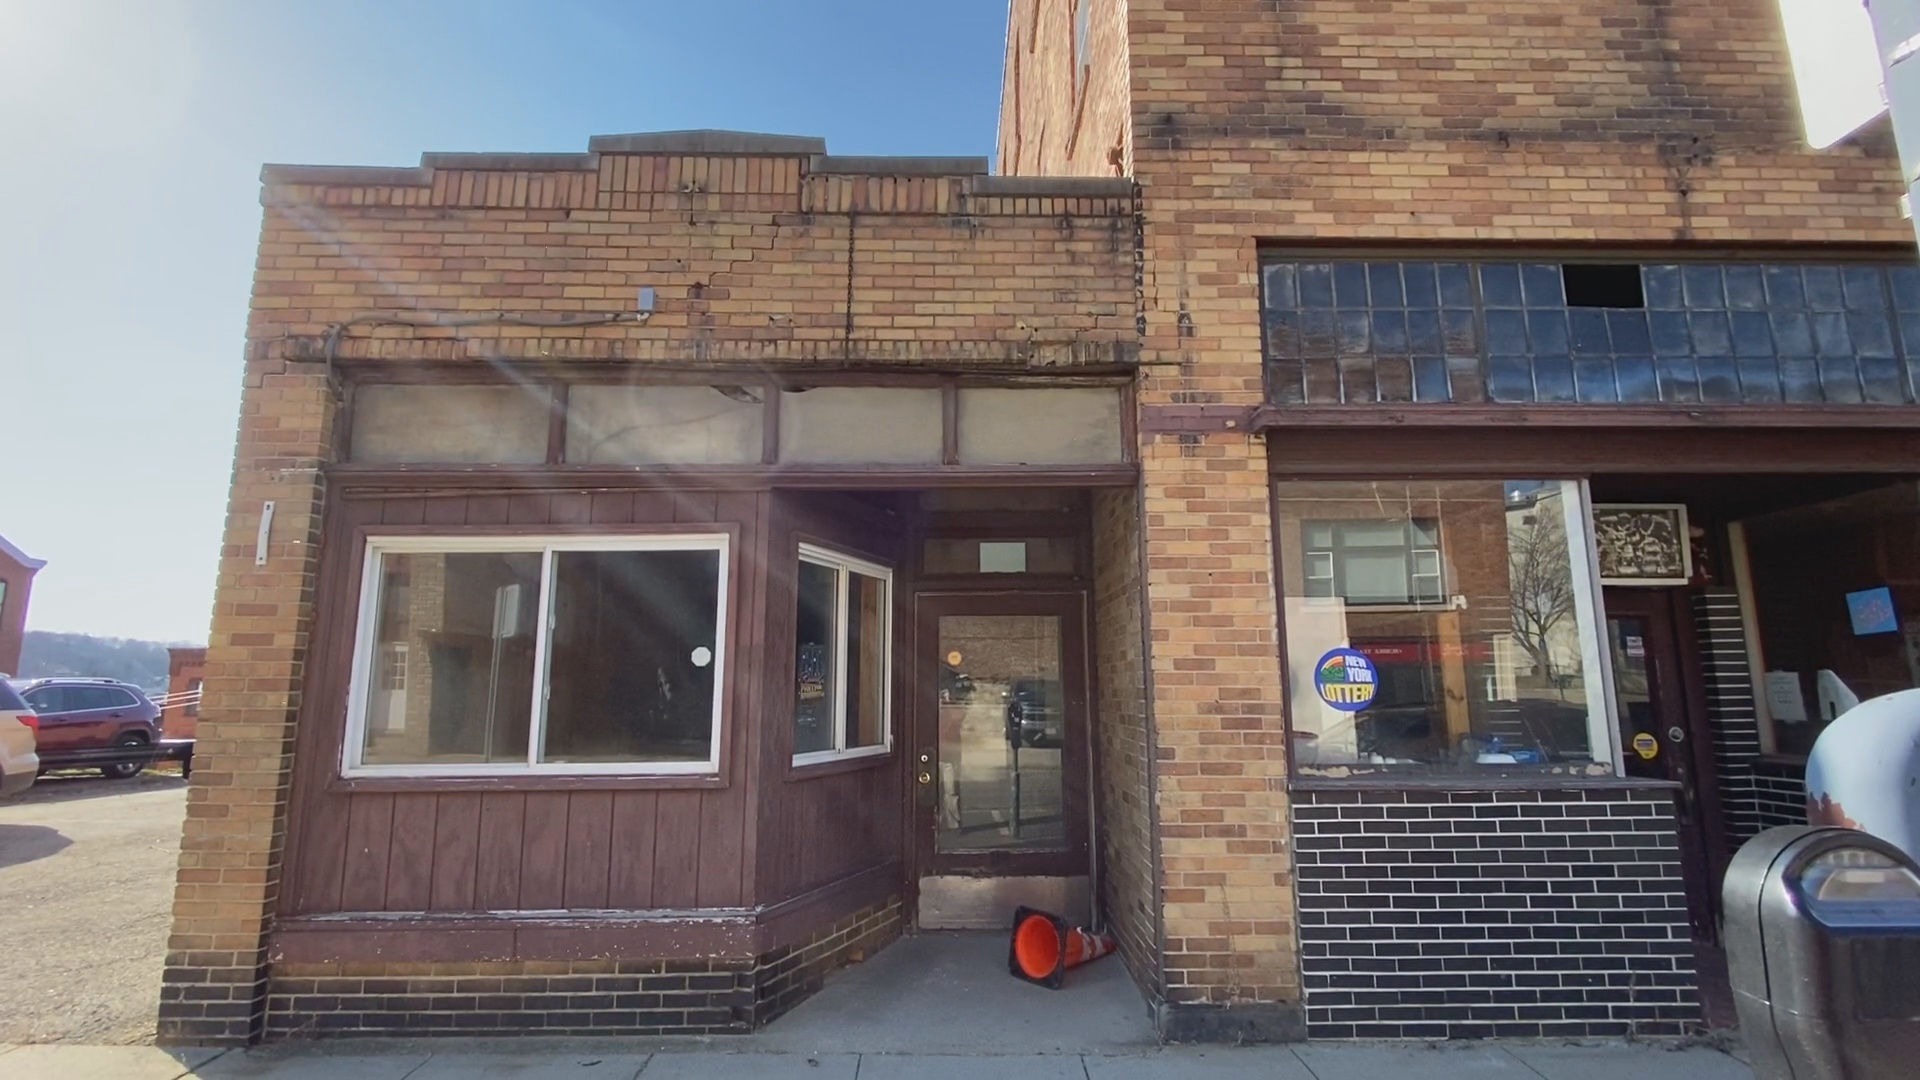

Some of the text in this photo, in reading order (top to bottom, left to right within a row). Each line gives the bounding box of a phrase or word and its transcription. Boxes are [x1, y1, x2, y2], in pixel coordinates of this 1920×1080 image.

[1345, 655, 1367, 668] NEW
[1347, 667, 1373, 682] YORK
[1320, 683, 1375, 703] LOTTERY
